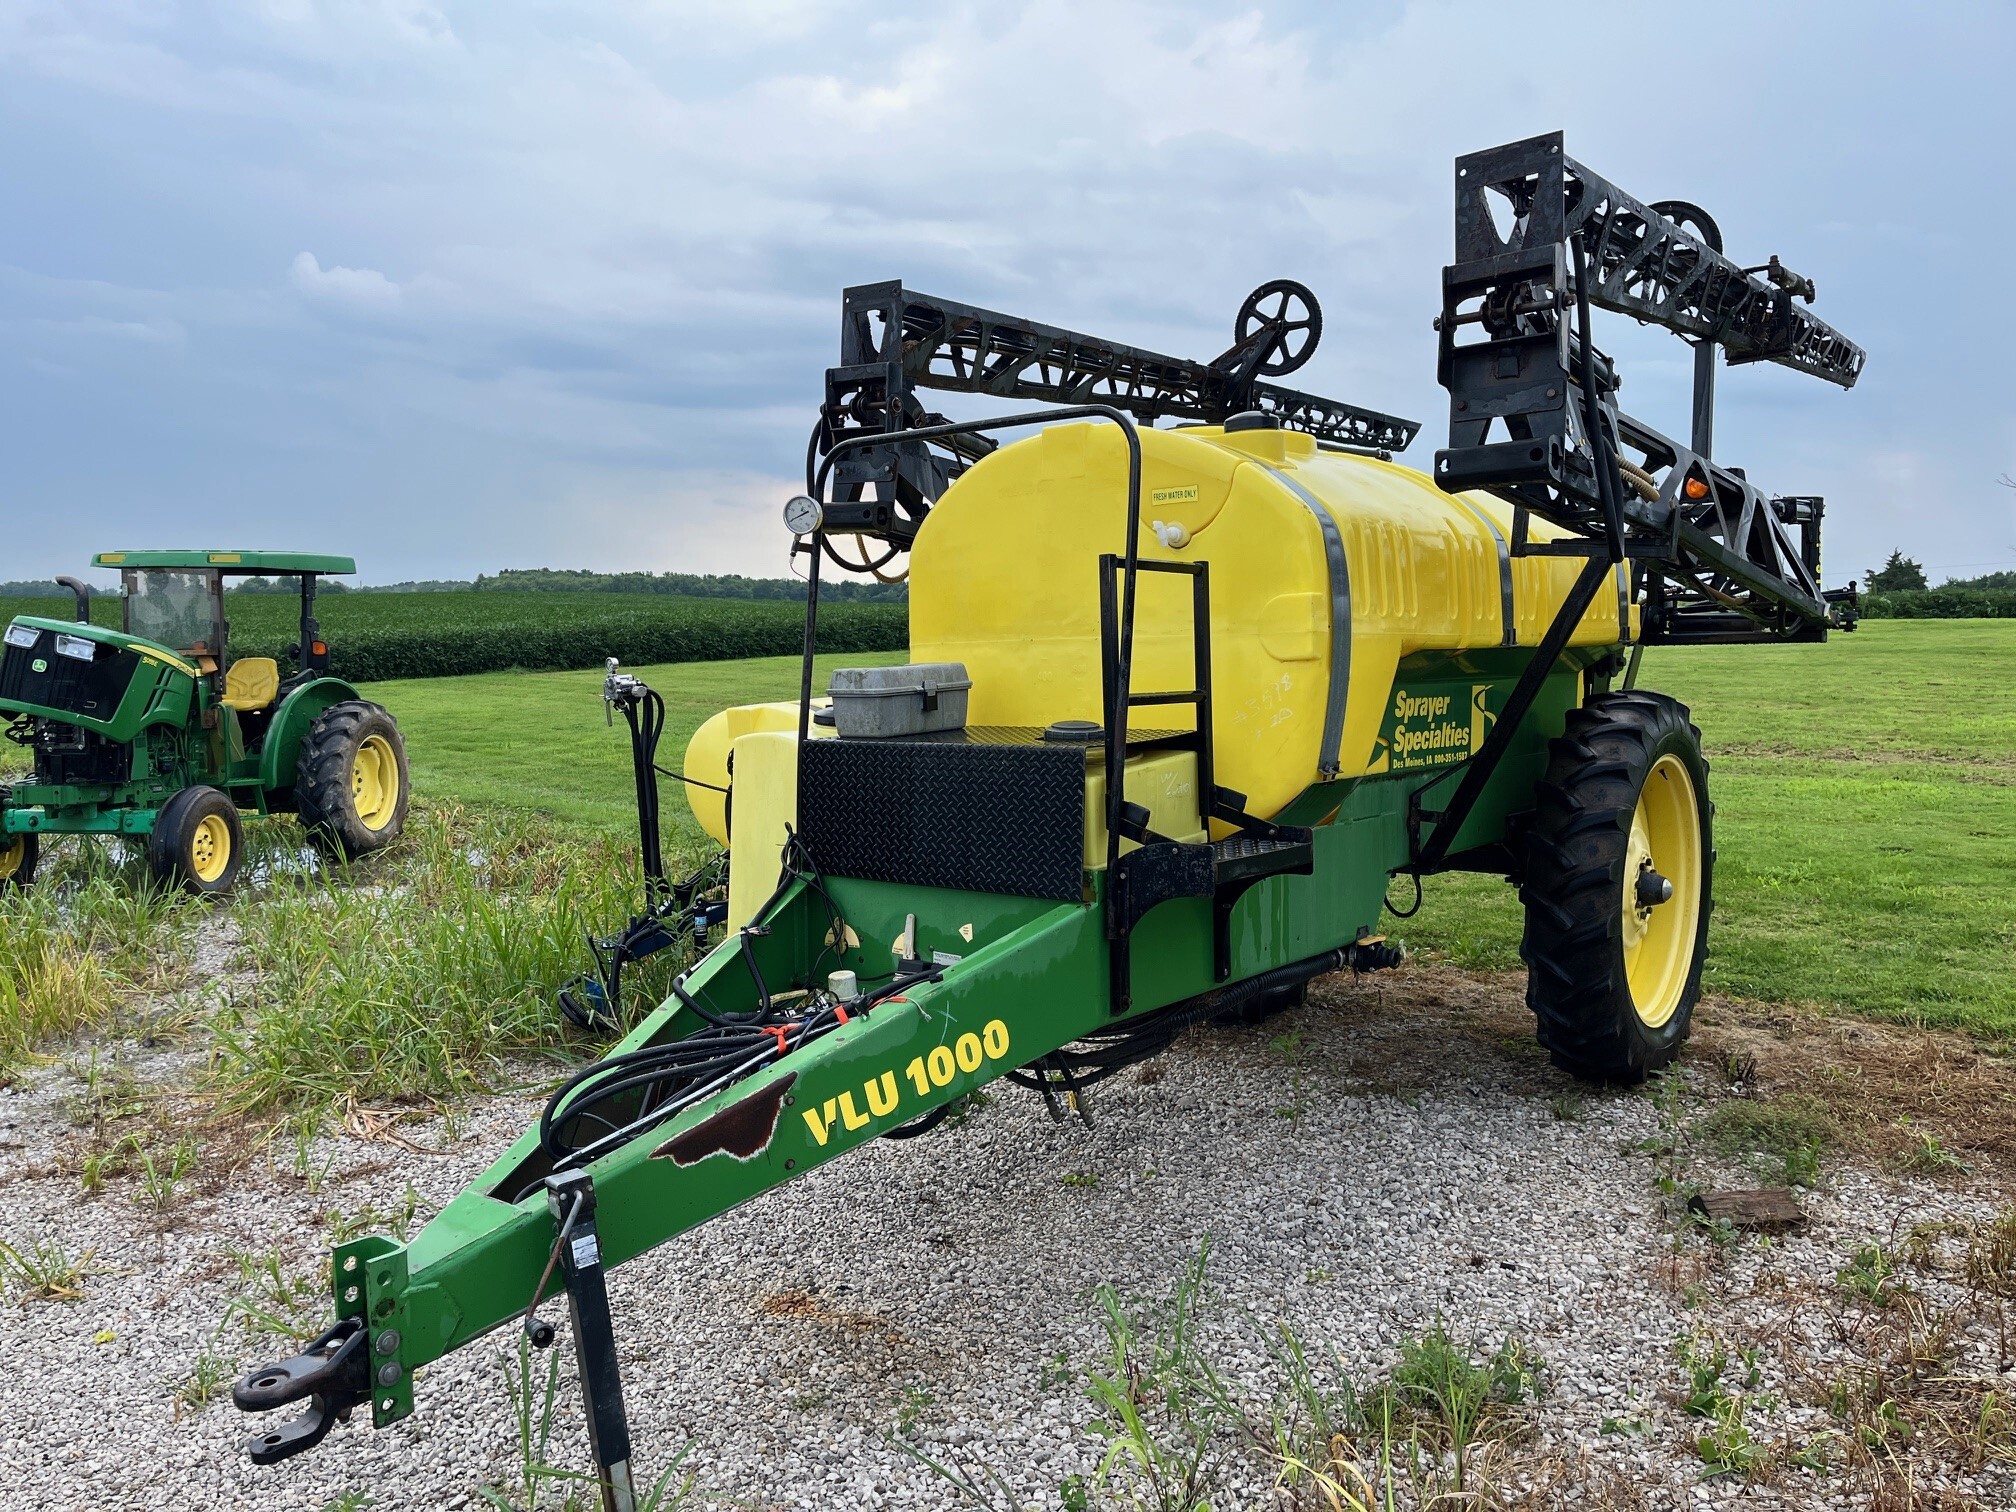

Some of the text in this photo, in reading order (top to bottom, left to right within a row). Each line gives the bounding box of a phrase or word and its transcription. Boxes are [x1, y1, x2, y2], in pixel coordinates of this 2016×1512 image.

[1153, 490, 1196, 501] FRESH WATER ONLY
[1395, 690, 1450, 723] Sprayer
[1393, 721, 1470, 758] Specialties
[1393, 759, 1404, 769] Des
[1405, 756, 1425, 767] Moines,
[1426, 755, 1433, 765] IA
[802, 1019, 1010, 1146] VLU 1000
